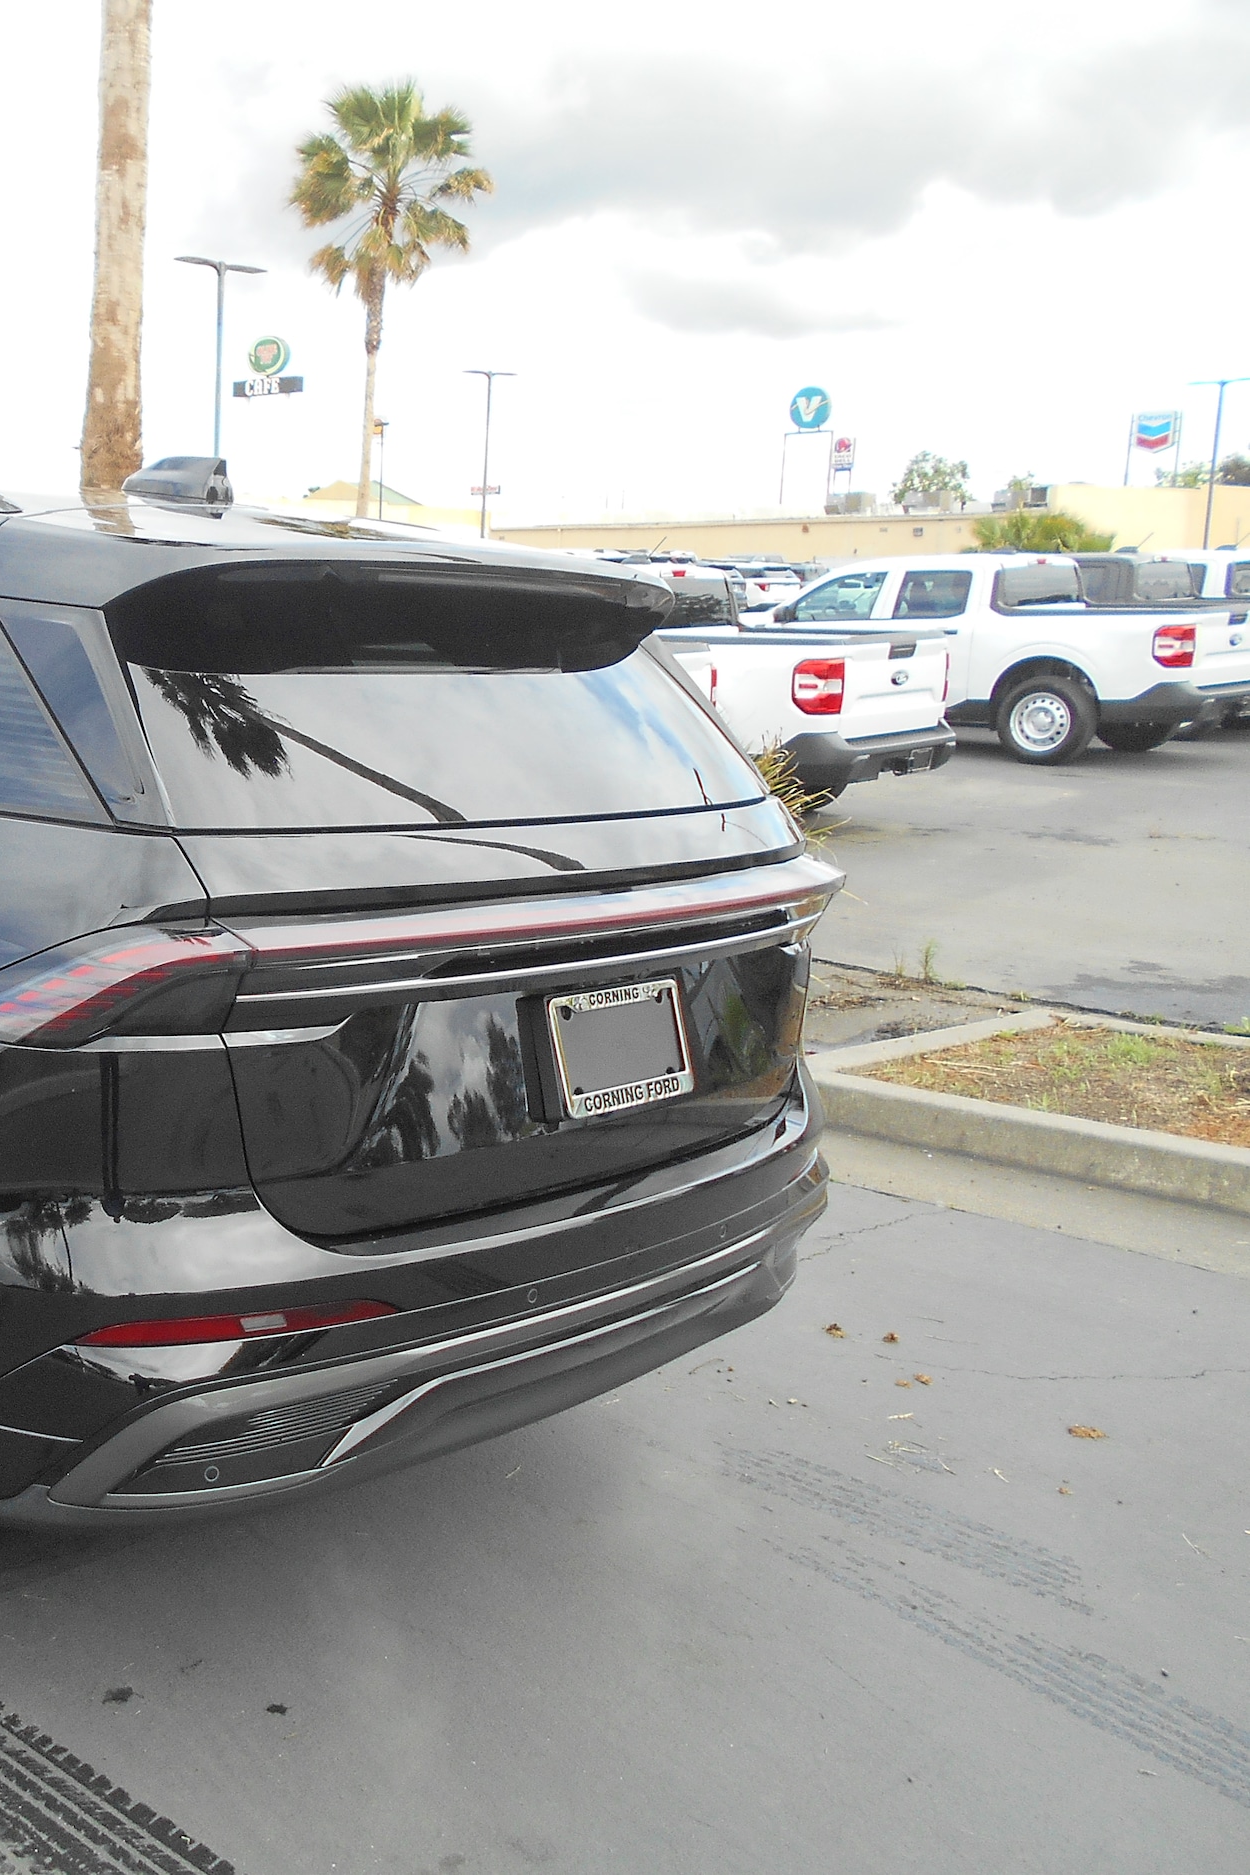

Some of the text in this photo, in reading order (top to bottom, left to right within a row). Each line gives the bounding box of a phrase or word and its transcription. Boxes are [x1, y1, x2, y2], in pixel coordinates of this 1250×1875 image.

[244, 377, 280, 397] CAFE
[589, 987, 639, 1006] CORNING
[584, 1077, 679, 1112] CORNING FORD
